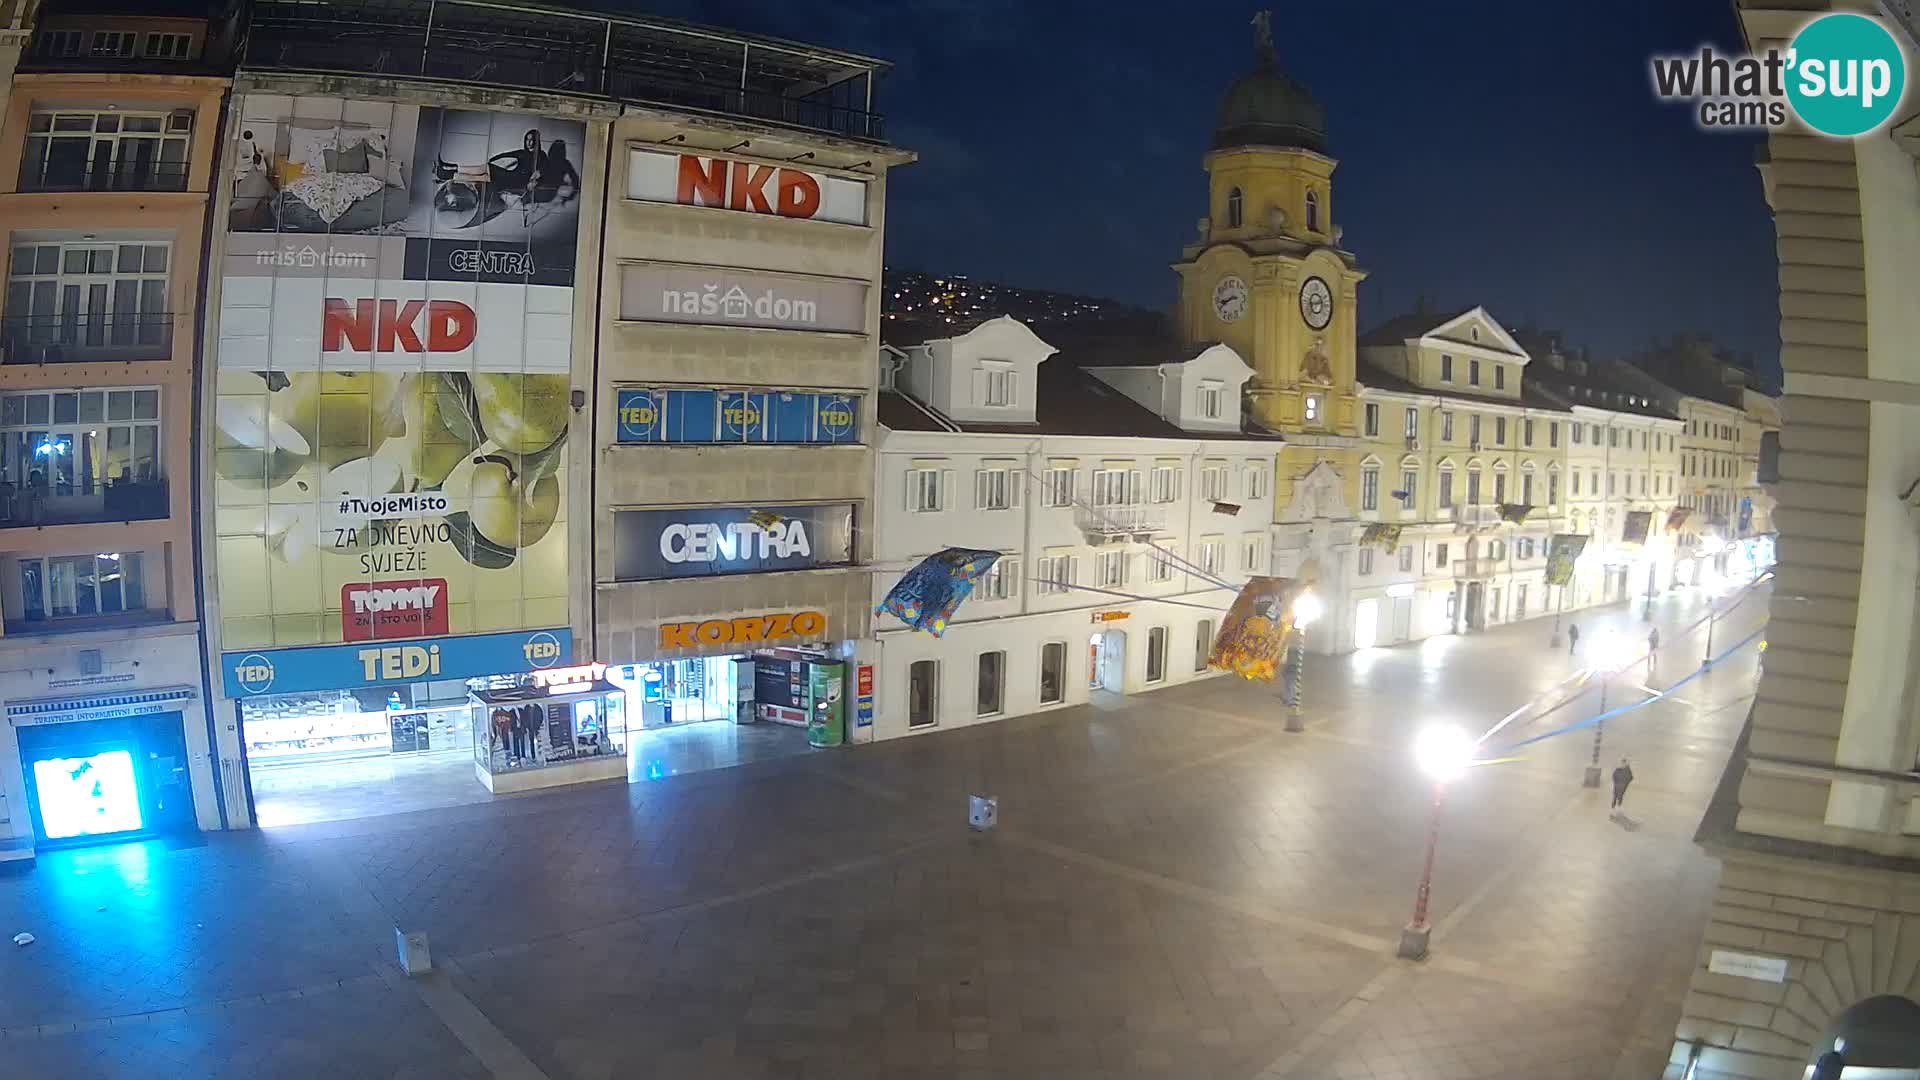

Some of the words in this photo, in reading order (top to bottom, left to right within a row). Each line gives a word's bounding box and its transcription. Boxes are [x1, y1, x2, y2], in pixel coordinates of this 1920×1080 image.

[676, 155, 821, 219] NKD
[256, 246, 296, 269] naš
[320, 247, 368, 270] dom
[447, 248, 536, 275] CENTRA
[661, 283, 719, 315] naš
[754, 288, 817, 322] dom
[322, 297, 478, 353] NKD
[339, 496, 448, 516] #TvojeMisto
[334, 527, 359, 548] ZA
[367, 522, 452, 547] DNEVNO
[659, 519, 811, 563] CENTRA
[360, 546, 428, 574] SVJEŽE
[349, 585, 440, 613] TOMMY
[659, 610, 827, 648] KORZO
[358, 644, 441, 681] TEDi
[522, 641, 561, 662] TEDi
[234, 664, 274, 683] TEDi
